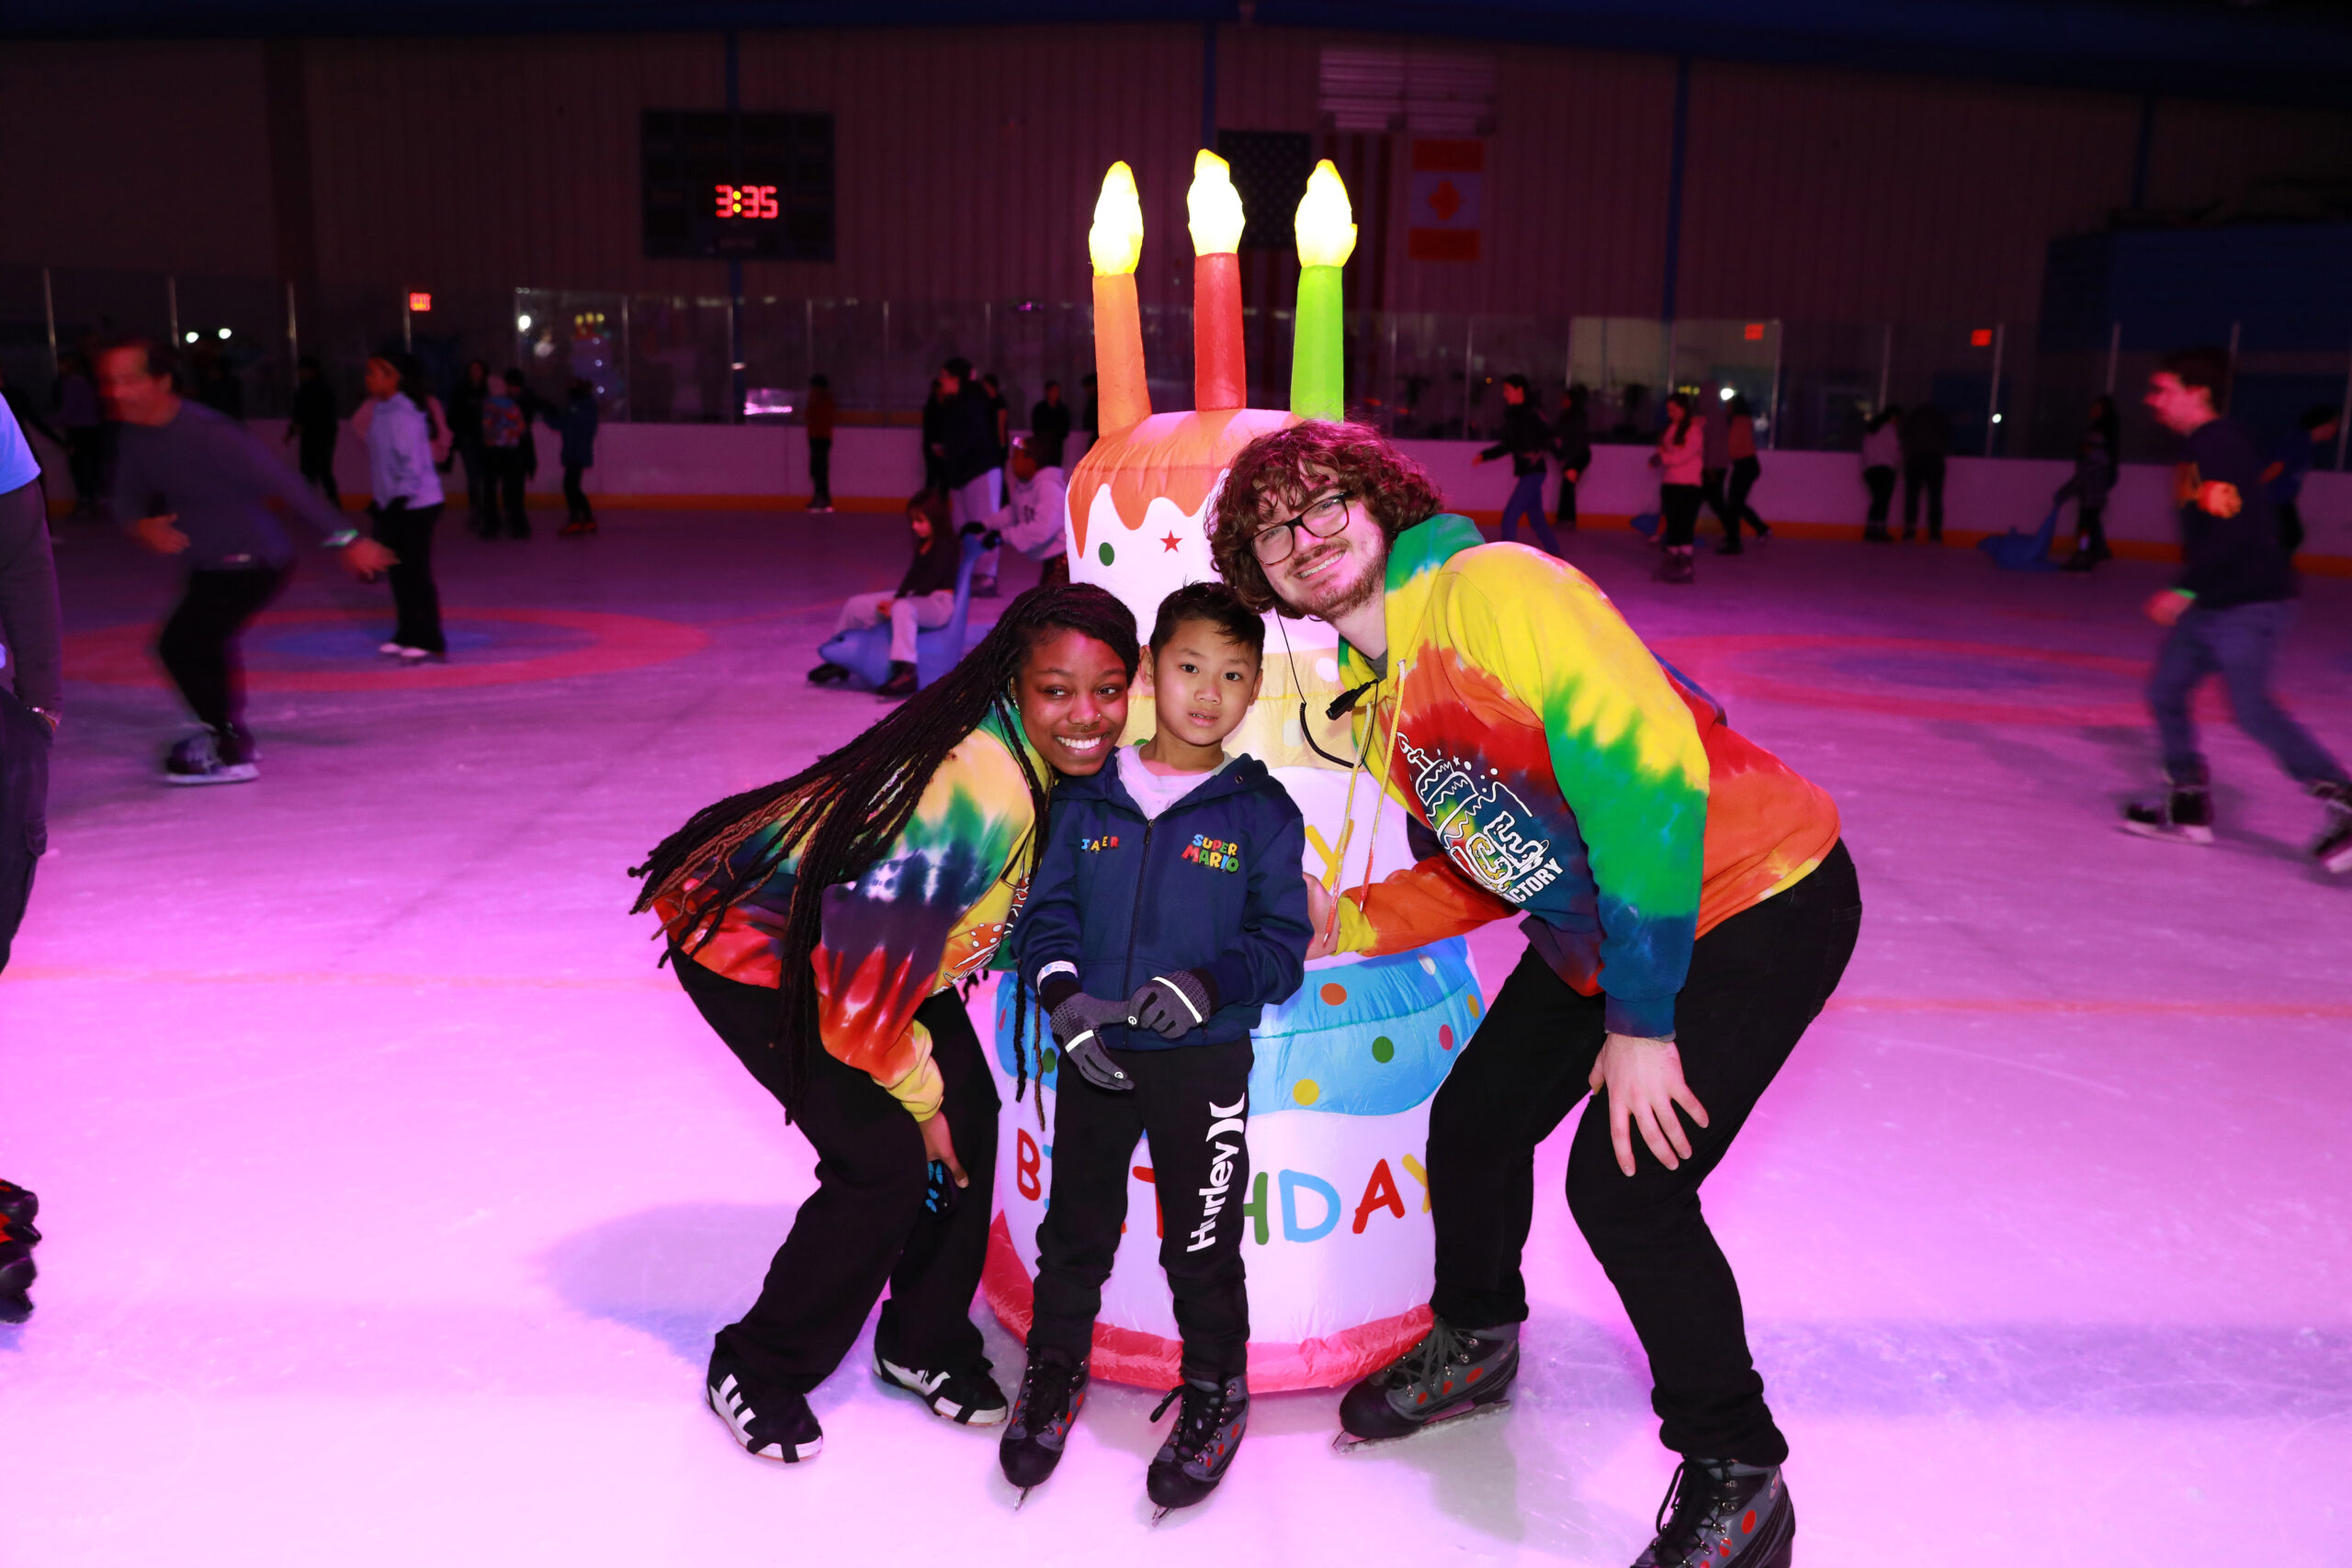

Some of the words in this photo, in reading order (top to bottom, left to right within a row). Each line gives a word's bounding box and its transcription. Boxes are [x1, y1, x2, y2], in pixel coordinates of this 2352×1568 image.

[715, 185, 778, 218] 3:35
[1080, 831, 1119, 852] JAER
[1193, 833, 1238, 856] SUPER
[1182, 844, 1239, 873] MARIO
[1505, 857, 1564, 904] CTORY
[1186, 1141, 1239, 1252] Hurley
